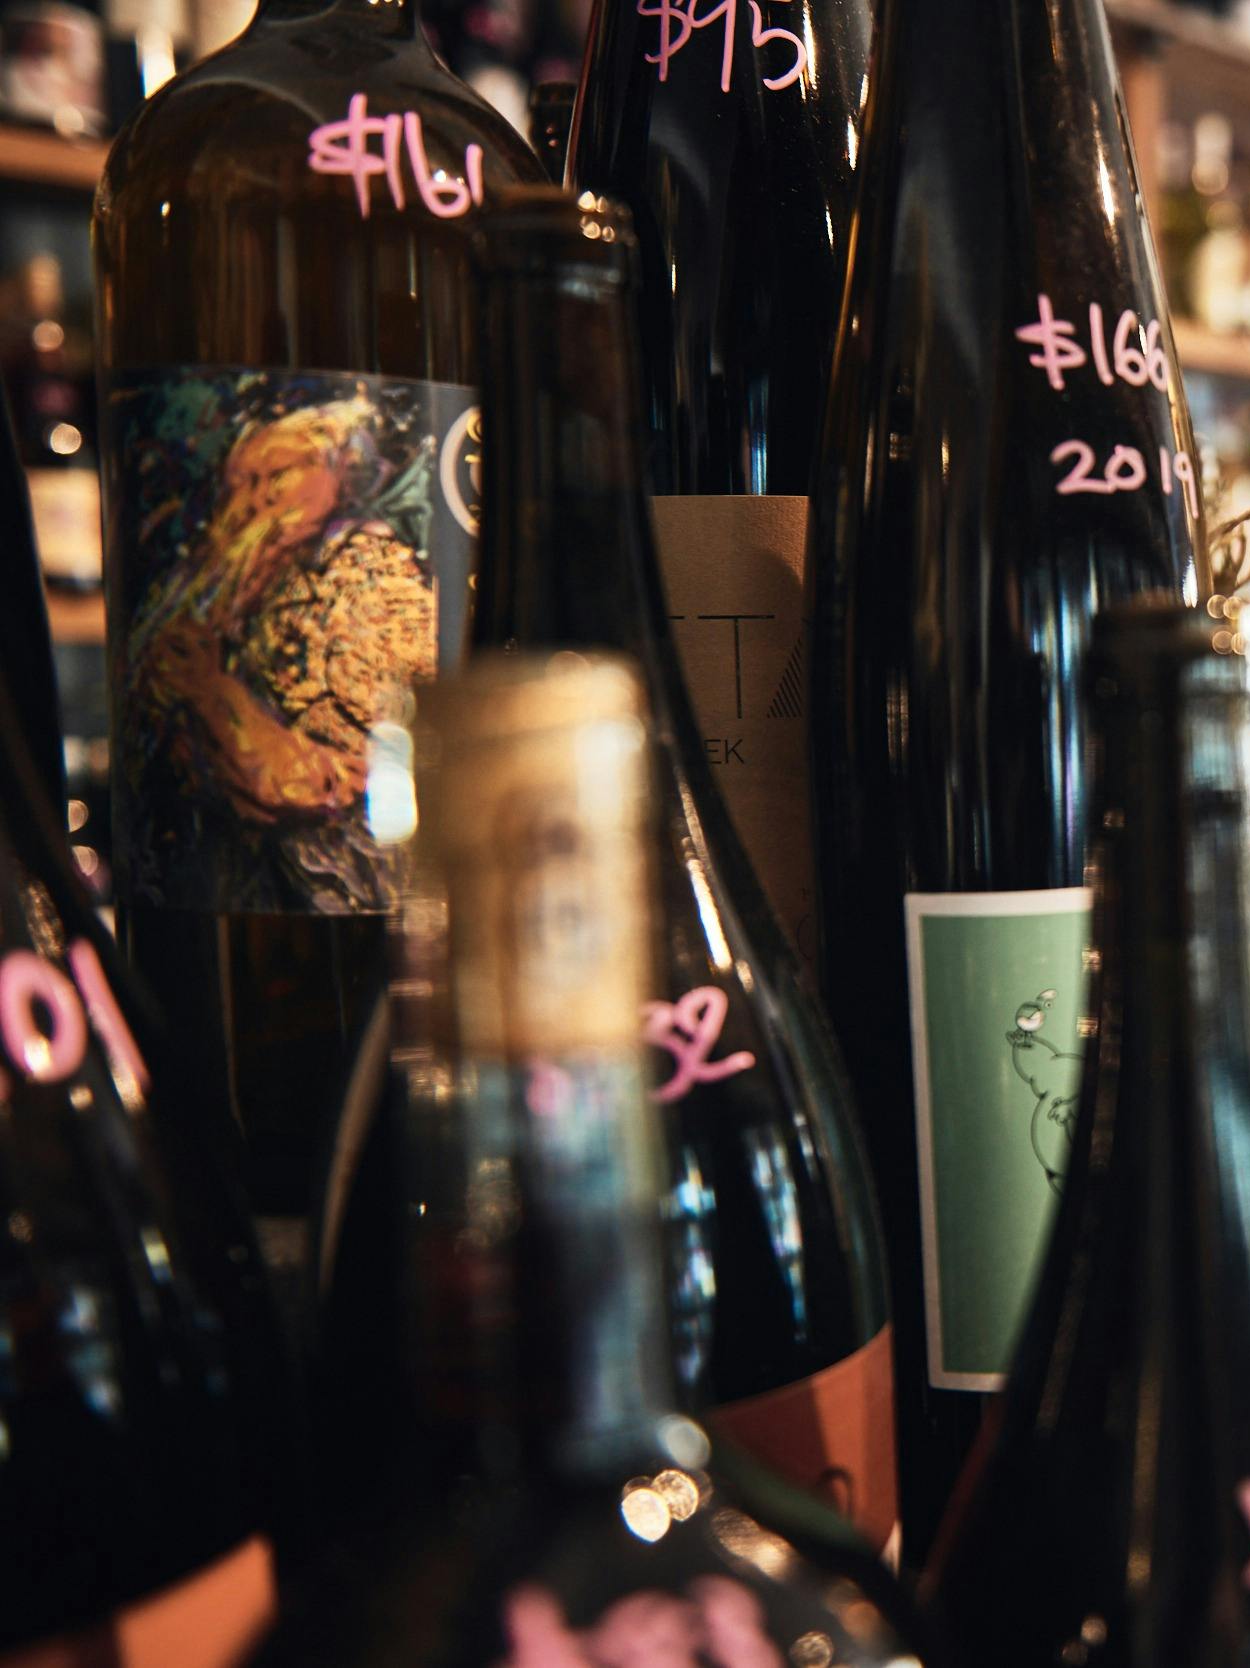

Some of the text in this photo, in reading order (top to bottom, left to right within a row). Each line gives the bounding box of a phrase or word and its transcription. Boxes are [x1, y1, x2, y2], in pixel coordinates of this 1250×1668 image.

[636, 0, 808, 92] $95
[308, 92, 484, 220] $161
[1014, 292, 1170, 393] $166
[1050, 438, 1200, 521] 2019
